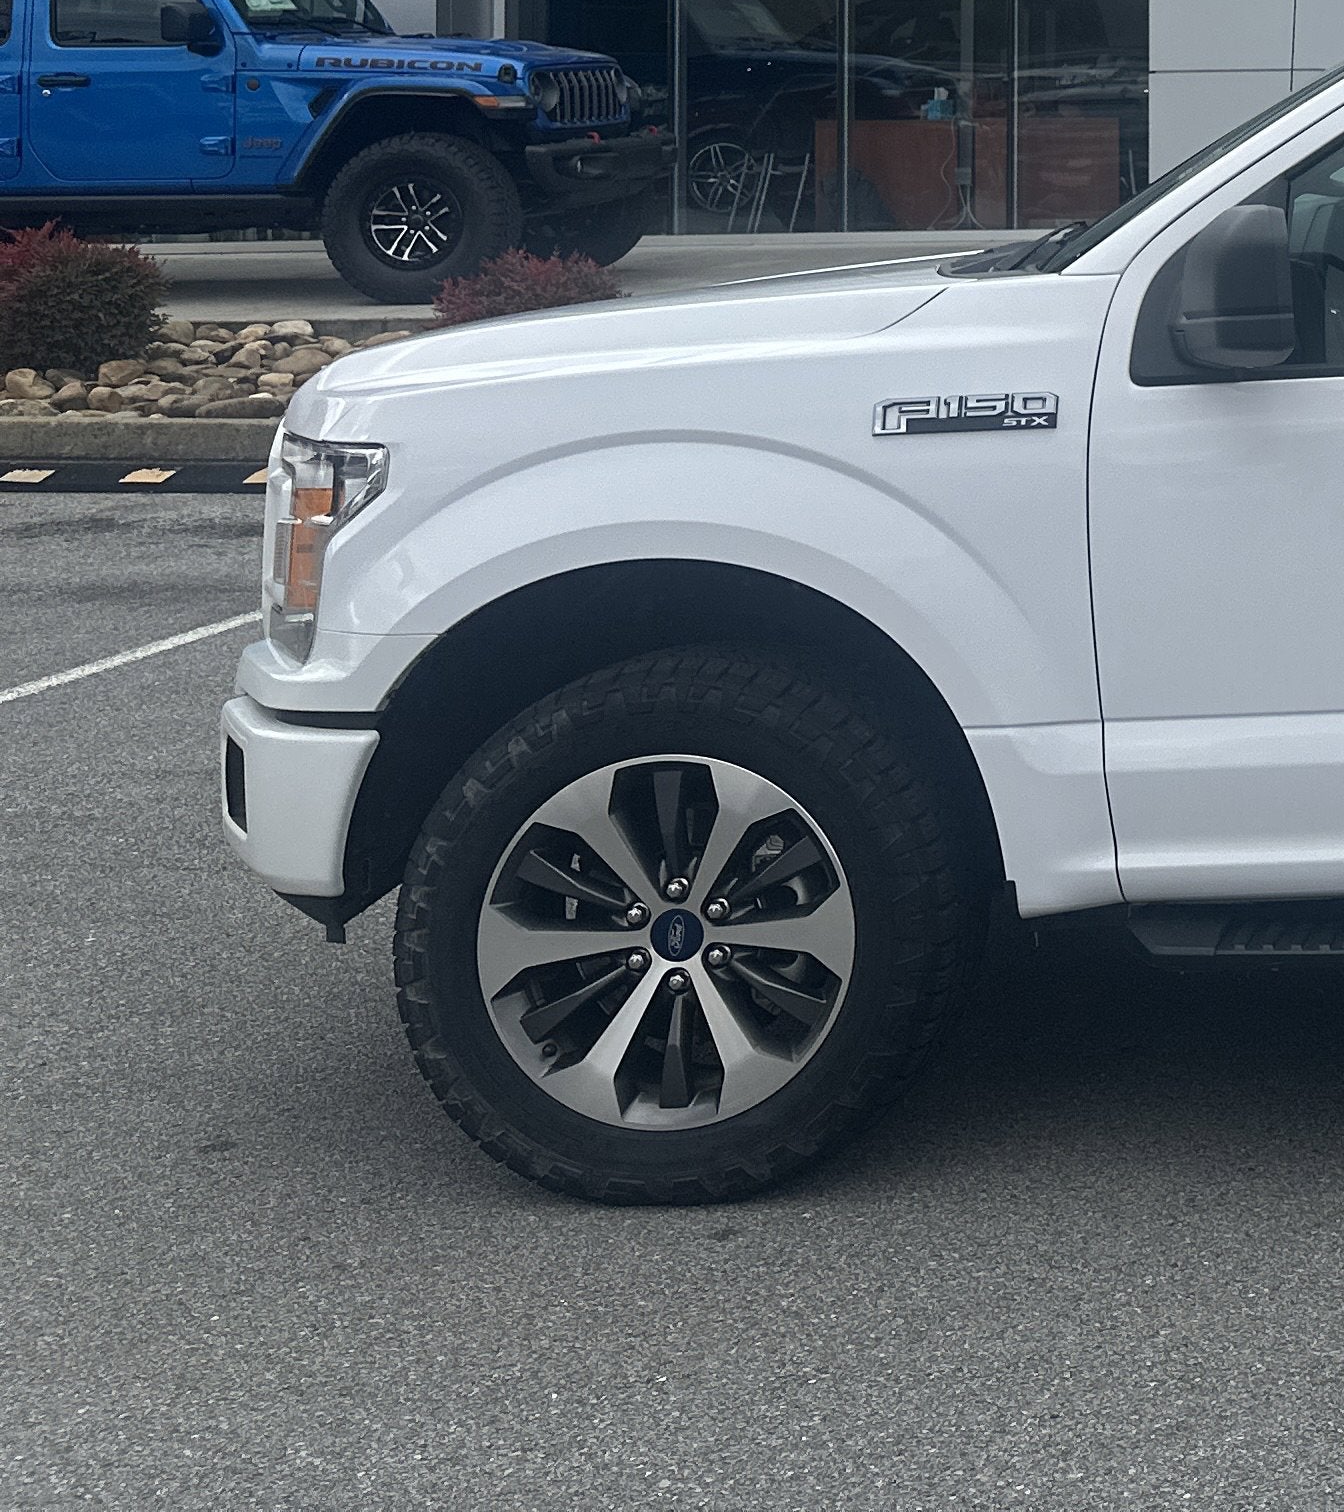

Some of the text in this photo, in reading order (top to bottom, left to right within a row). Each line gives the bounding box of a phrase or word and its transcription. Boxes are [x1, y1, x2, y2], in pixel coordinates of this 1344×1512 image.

[315, 56, 483, 72] RUBICON
[872, 391, 1059, 436] F150
[1002, 415, 1049, 427] STX
